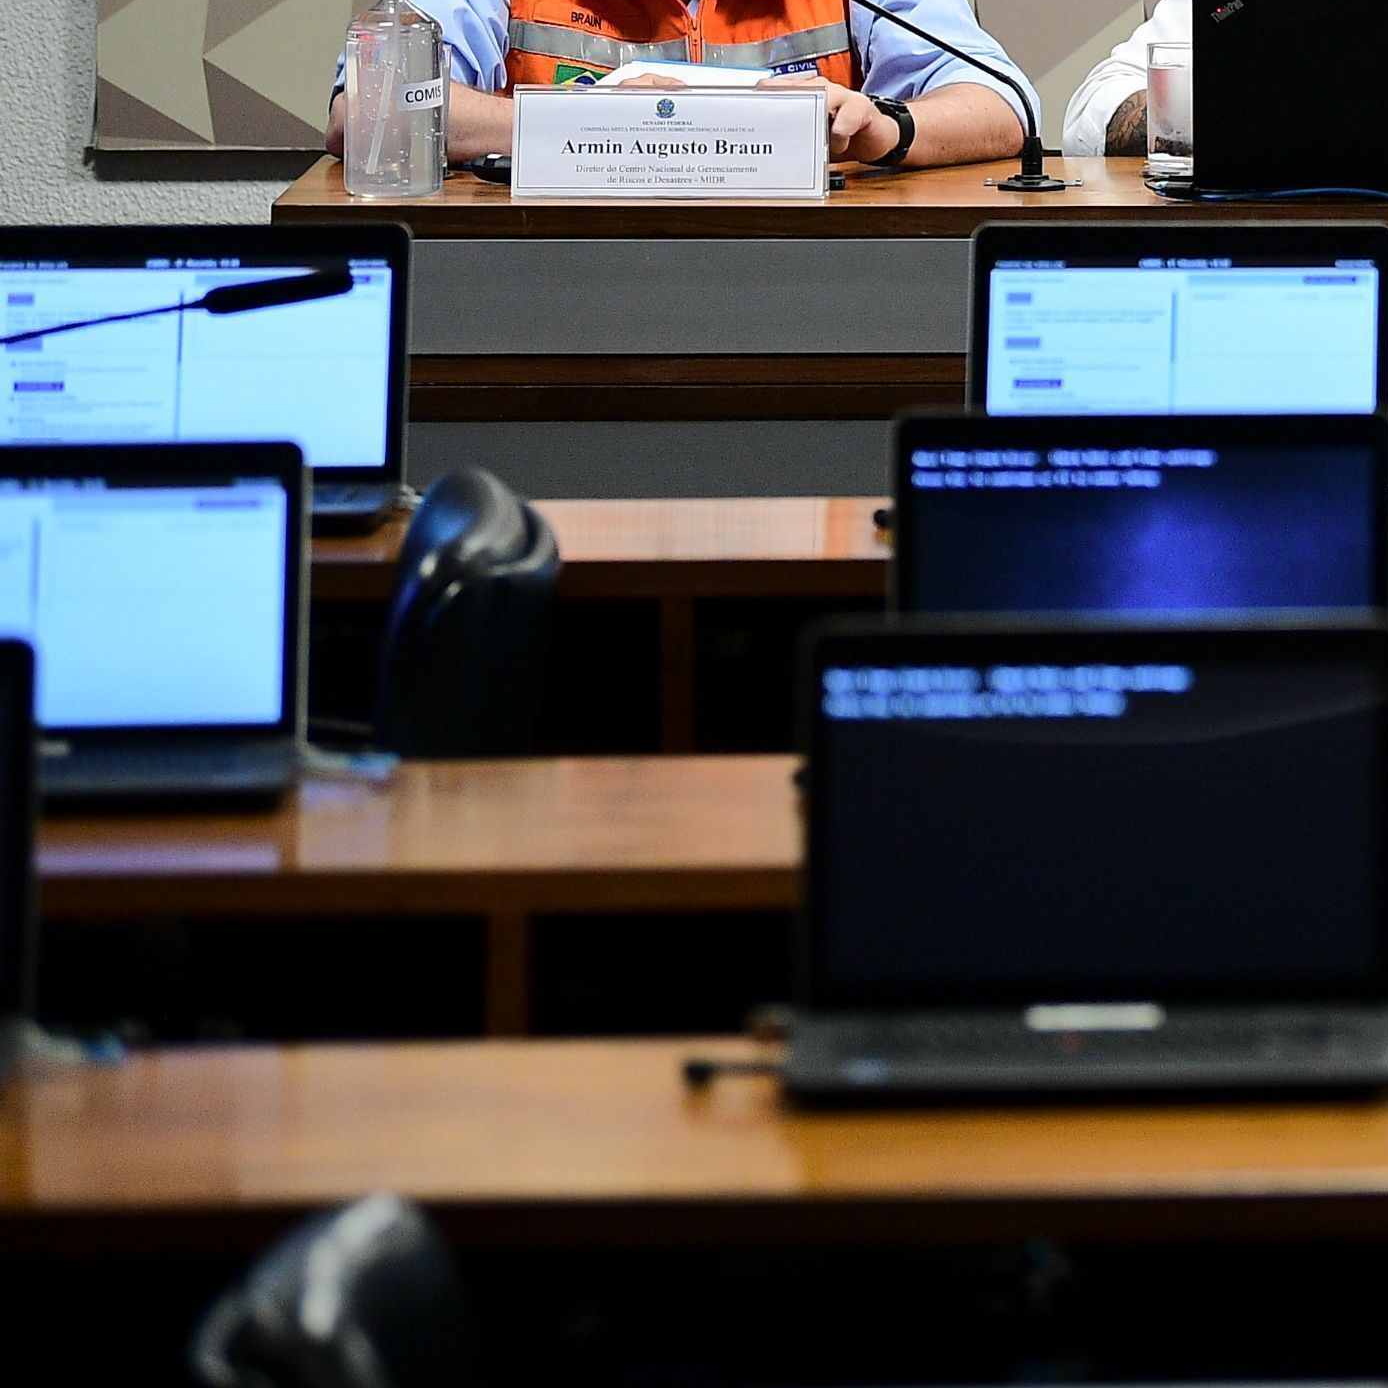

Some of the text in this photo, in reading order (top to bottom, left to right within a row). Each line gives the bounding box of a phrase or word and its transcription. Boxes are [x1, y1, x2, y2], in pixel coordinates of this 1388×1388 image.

[571, 11, 602, 30] BRAUN
[787, 61, 817, 73] CIVIL
[561, 139, 773, 159] Armin Augusto Braun
[575, 163, 758, 173] Diretor do Centro Nacional de Gerenciamento
[606, 175, 617, 184] de
[618, 175, 646, 184] Riscos
[654, 175, 693, 184] Desastres
[700, 175, 726, 184] MIDR
